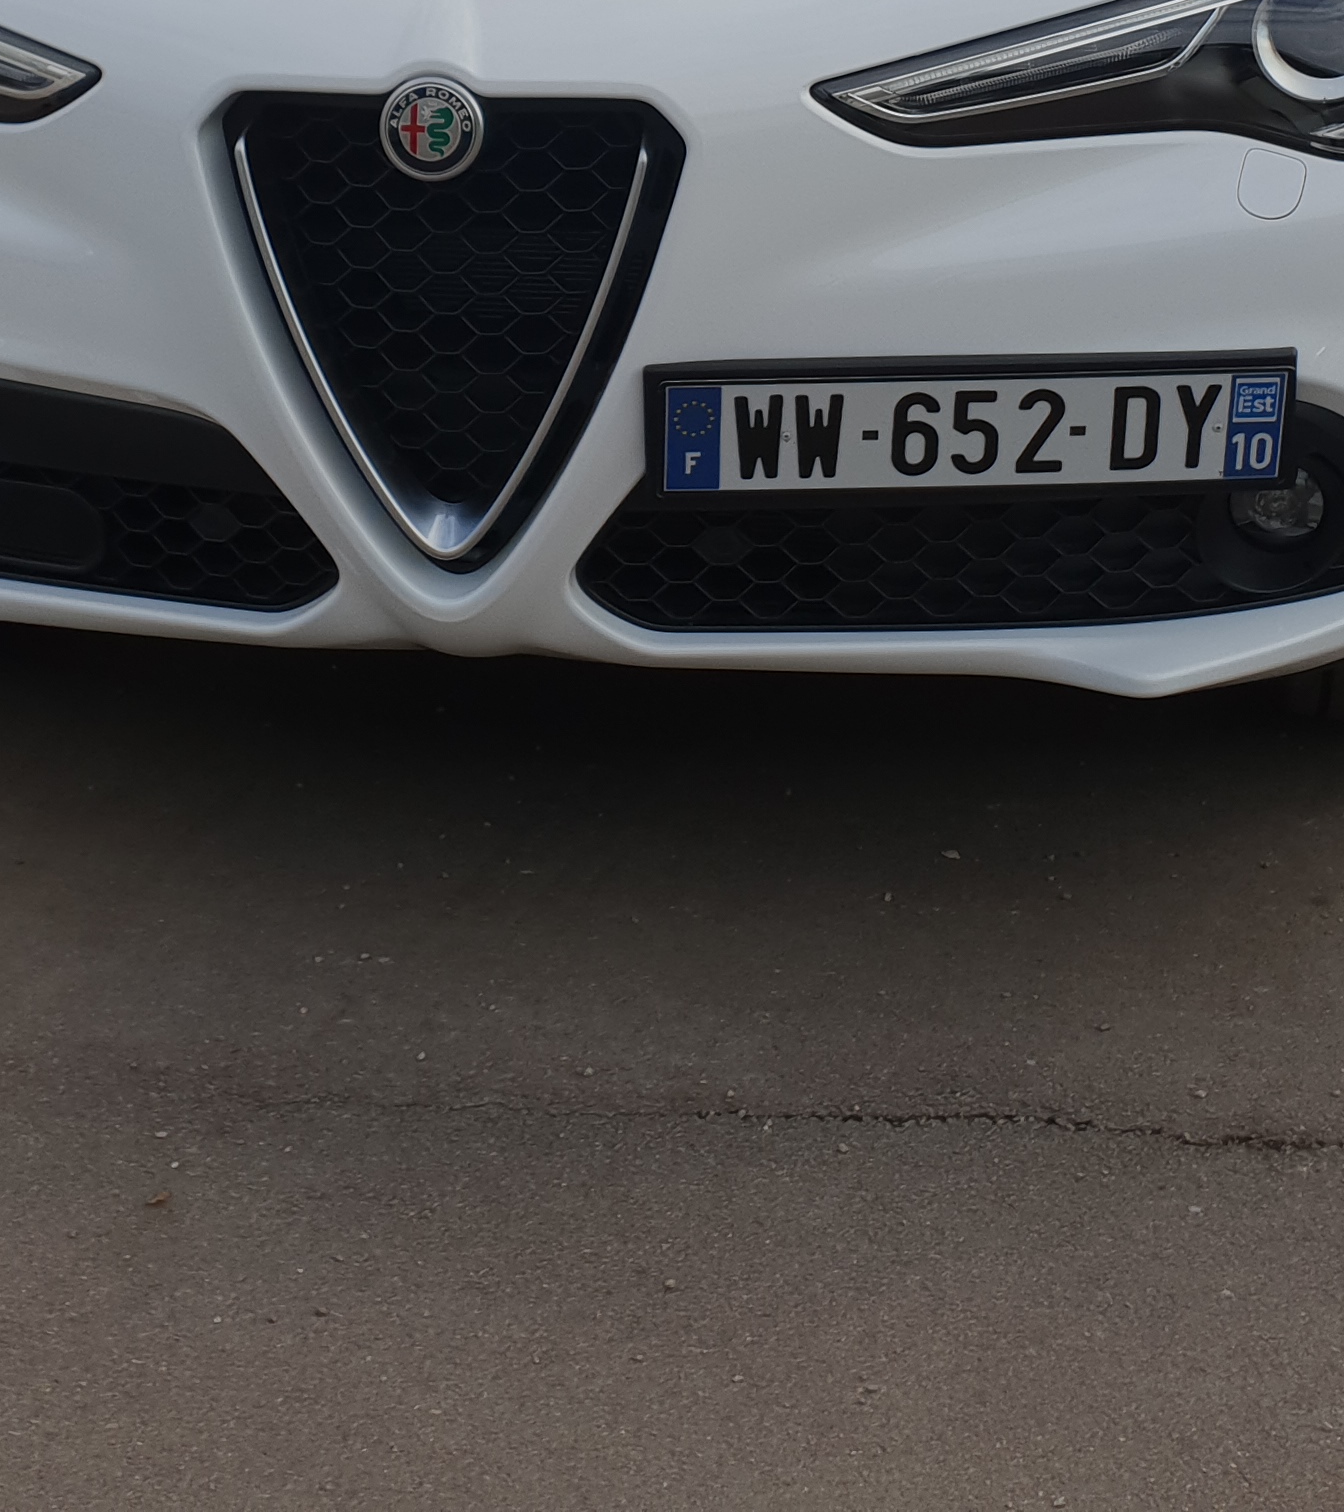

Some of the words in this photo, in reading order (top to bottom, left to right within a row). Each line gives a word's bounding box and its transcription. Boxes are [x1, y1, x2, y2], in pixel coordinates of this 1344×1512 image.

[389, 92, 419, 129] ALFA
[425, 86, 472, 133] ROMEO
[1237, 395, 1275, 414] Est
[1239, 384, 1276, 396] Grand
[734, 383, 1223, 480] WW-652-DY
[684, 451, 702, 475] F
[1231, 432, 1274, 472] 10
